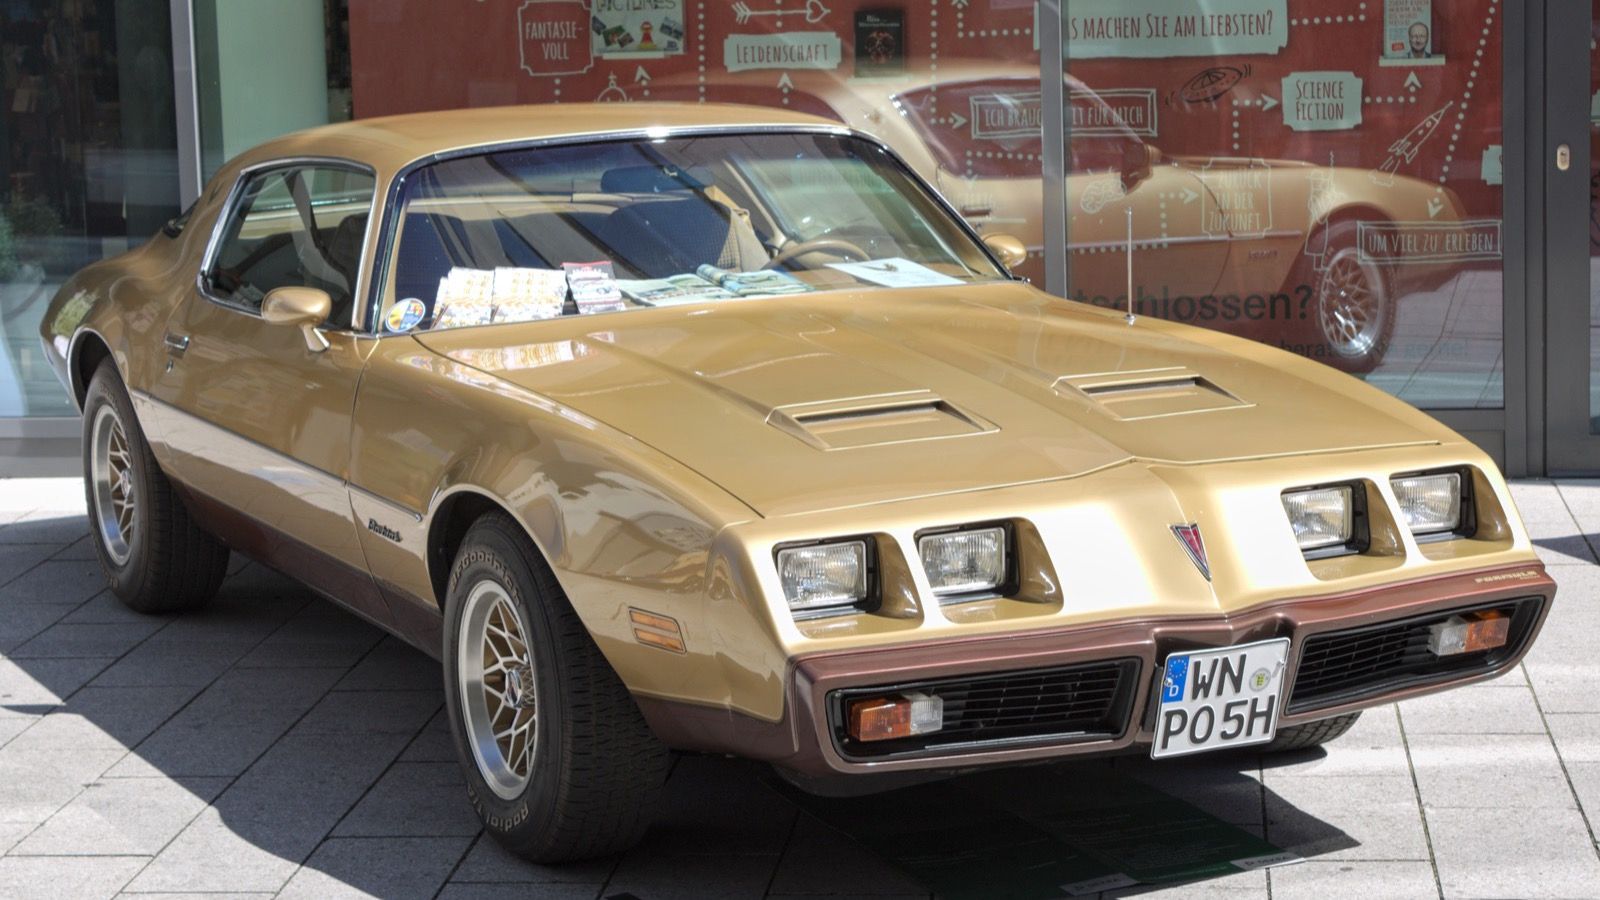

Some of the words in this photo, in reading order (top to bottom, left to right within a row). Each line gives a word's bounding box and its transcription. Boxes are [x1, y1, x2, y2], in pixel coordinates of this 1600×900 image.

[525, 21, 584, 40] FANTASIE-
[1083, 16, 1141, 40] MACHEN
[1146, 13, 1169, 38] SIE
[1174, 15, 1196, 38] AM
[1201, 9, 1273, 38] LIEBSTEN?
[541, 42, 570, 60] VOLL
[736, 43, 828, 64] LEIDENSCHAFT
[1296, 79, 1344, 99] SCIENCE
[984, 108, 1004, 128] ICH
[1008, 106, 1041, 128] BRAUC
[1112, 105, 1143, 126] MICH
[1296, 102, 1344, 121] FICTION
[1234, 192, 1254, 210] DER
[1208, 211, 1260, 232] ZUKUNFT
[1369, 234, 1387, 253] UM
[1392, 233, 1418, 252] VIEL
[1423, 233, 1438, 252] ZU
[1446, 233, 1493, 252] ERLEBEN
[1168, 685, 1179, 697] D
[1191, 653, 1247, 701] WN
